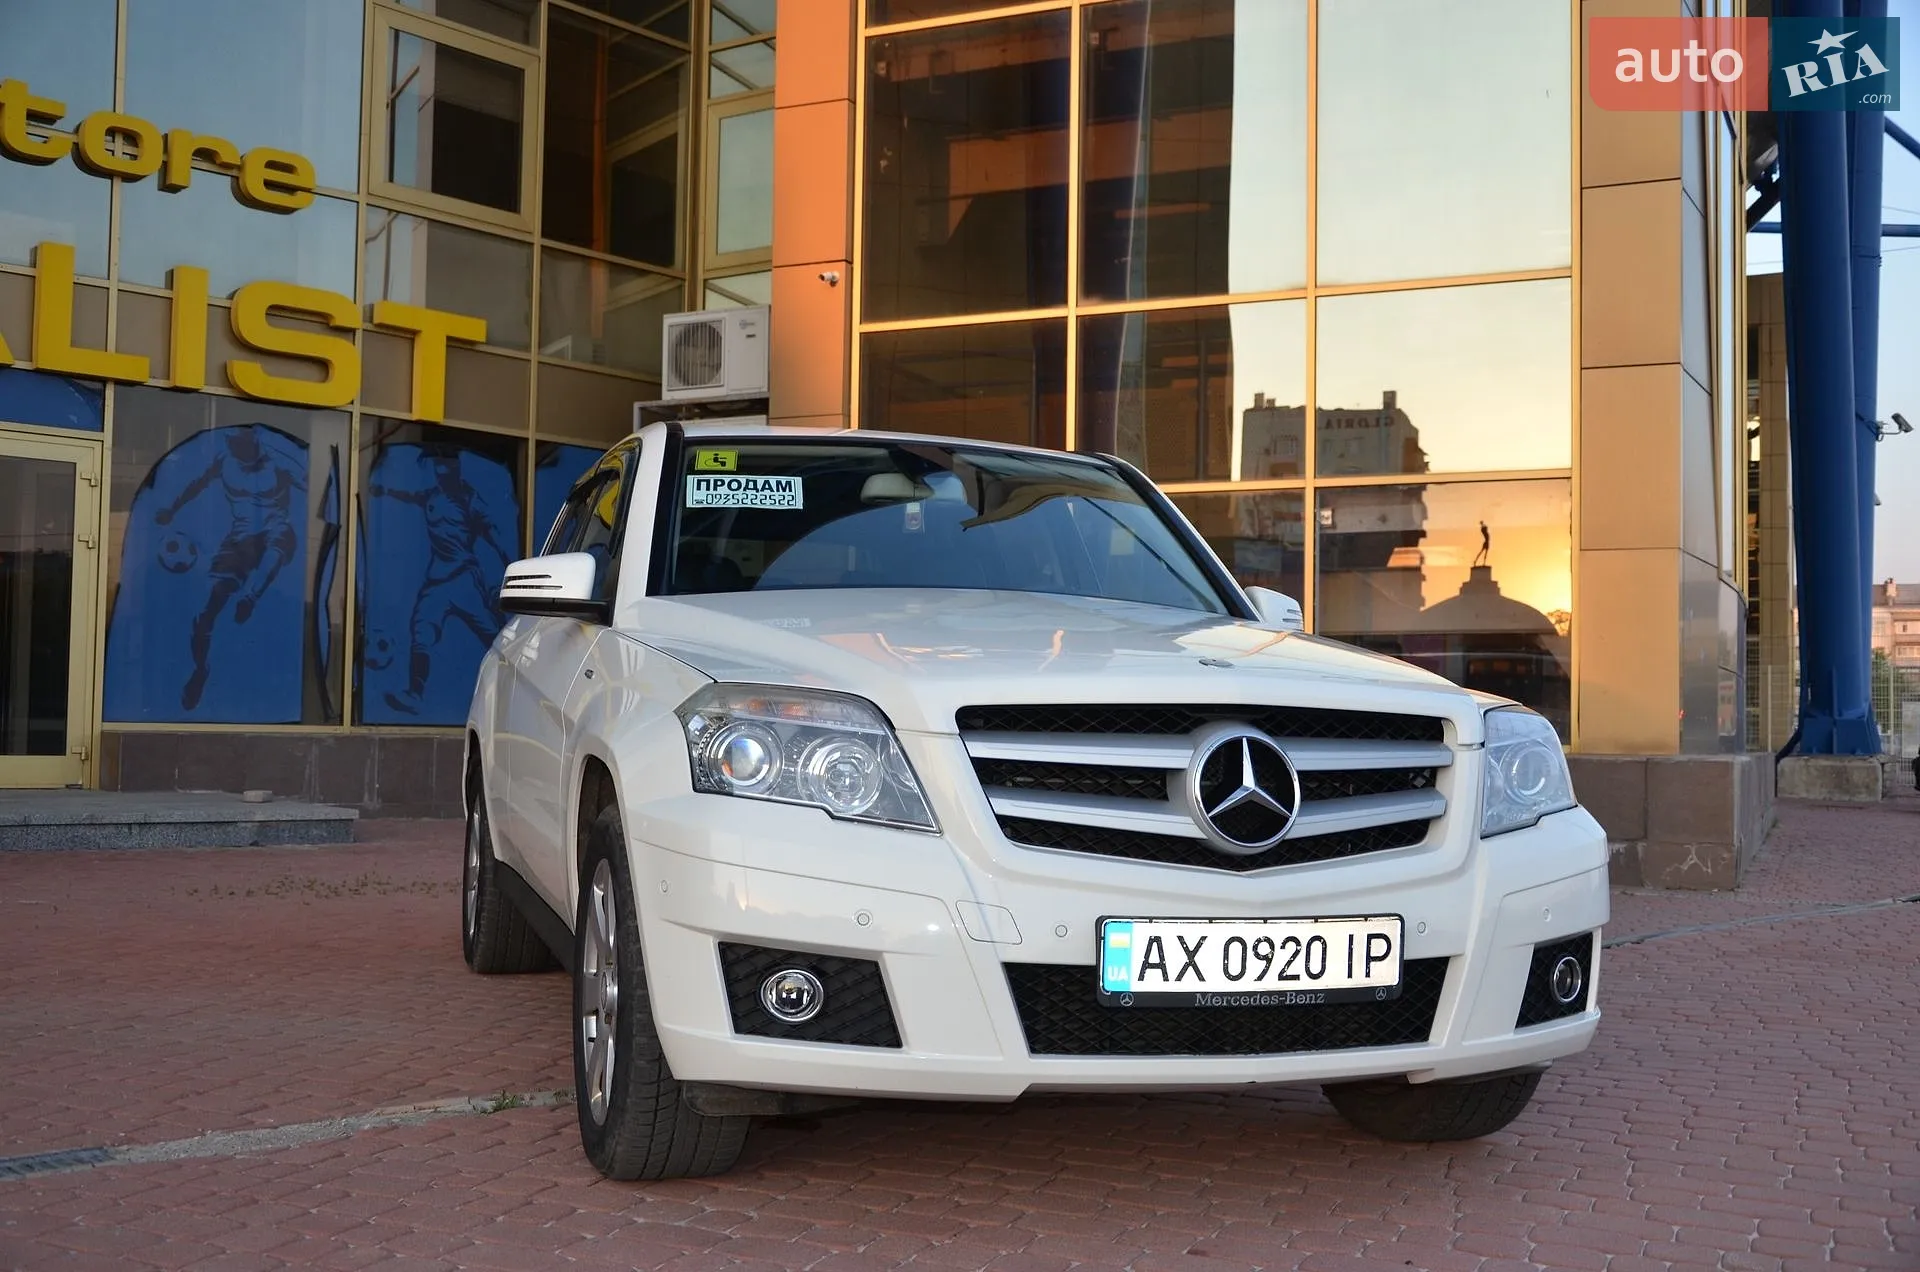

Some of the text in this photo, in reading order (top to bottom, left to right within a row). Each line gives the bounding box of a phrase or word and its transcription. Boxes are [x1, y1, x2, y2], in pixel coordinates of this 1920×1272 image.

[0, 240, 487, 423] LIST
[696, 478, 793, 493] ПРОДАМ
[1137, 932, 1392, 982] AX 0920 IP
[1107, 964, 1129, 983] UA
[1194, 991, 1325, 1007] Mercedes-Benz
